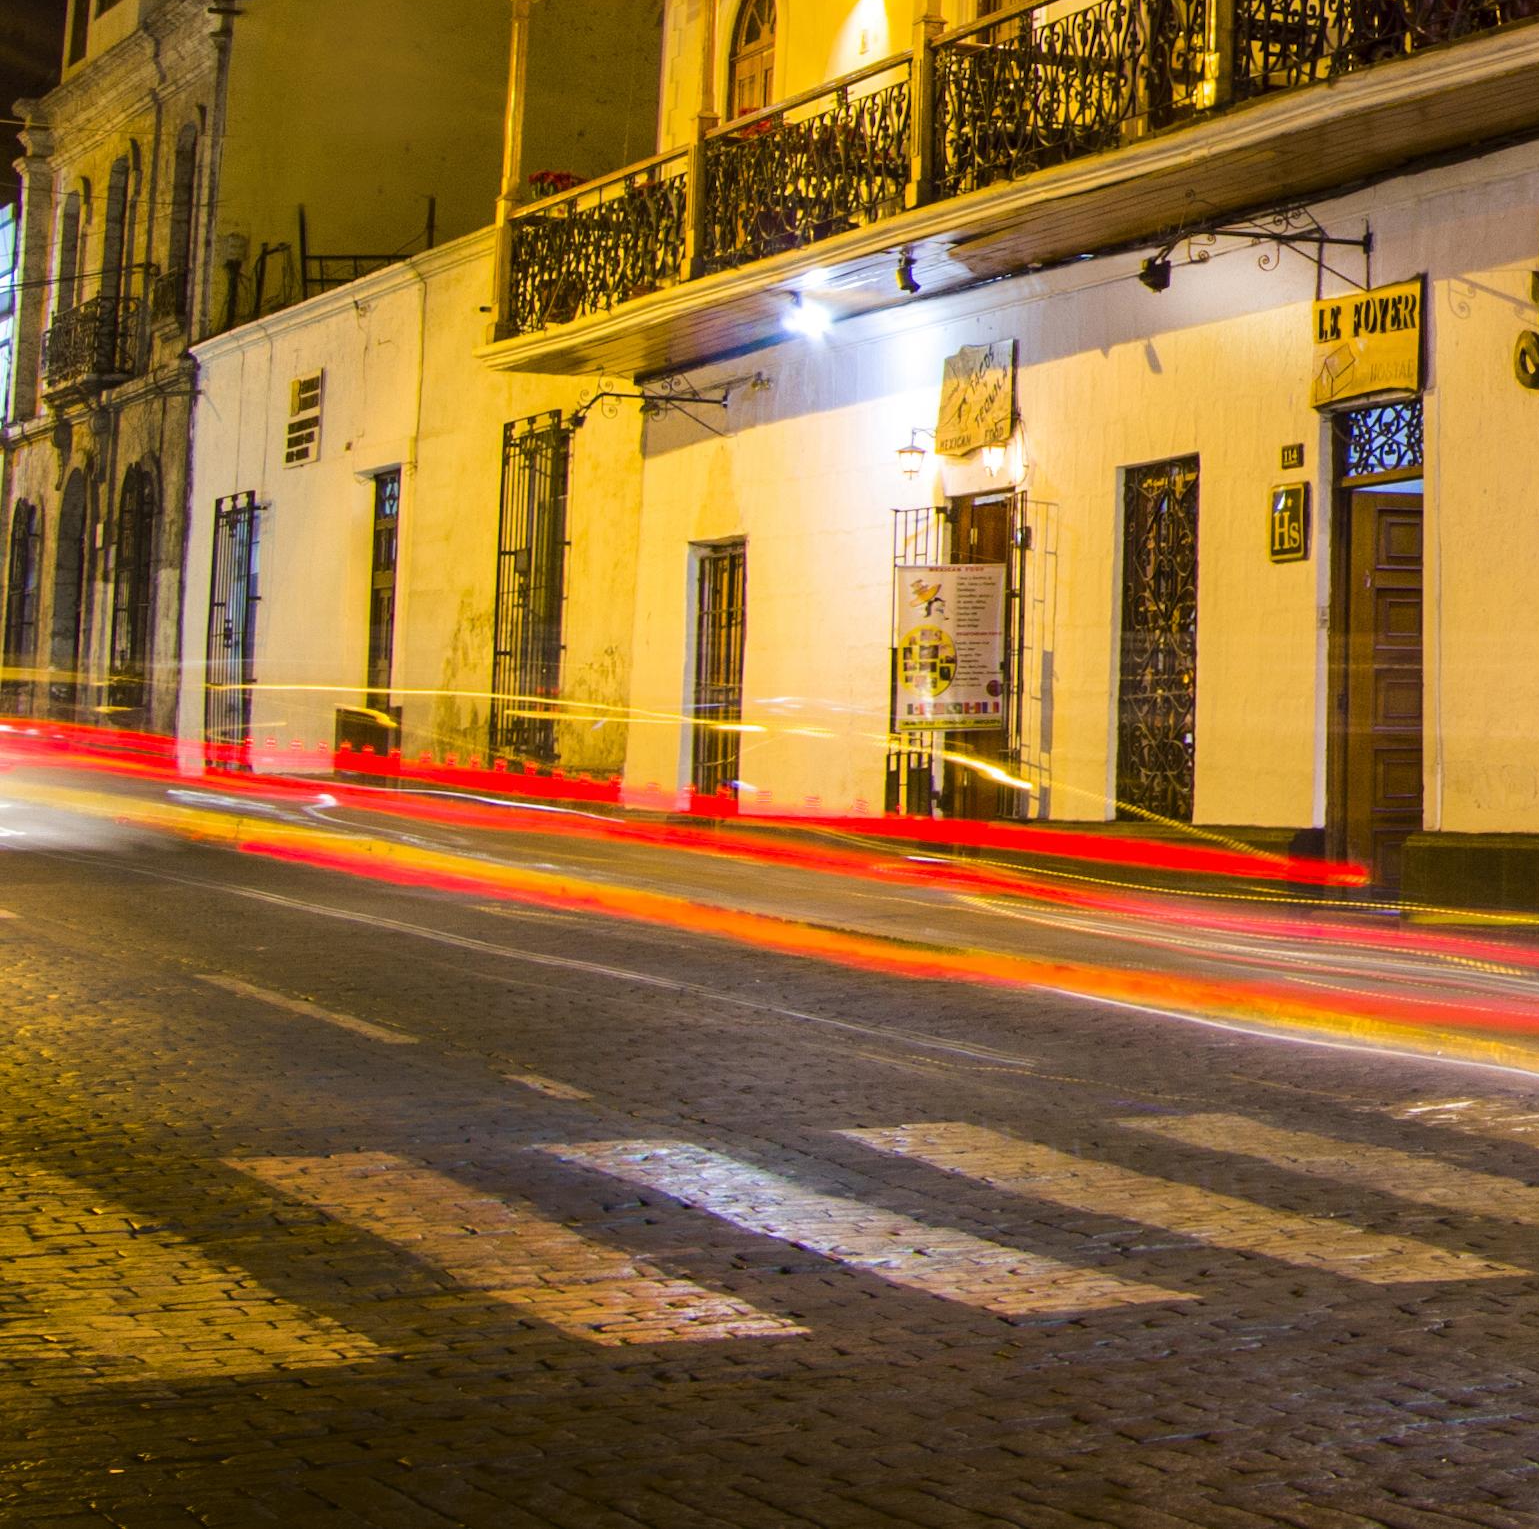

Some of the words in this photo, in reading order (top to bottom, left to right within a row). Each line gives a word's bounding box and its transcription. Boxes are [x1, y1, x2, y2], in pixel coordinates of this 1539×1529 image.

[1319, 306, 1341, 343] LE
[1353, 294, 1416, 337] FOYER
[971, 343, 994, 393] TACOS
[1370, 359, 1412, 383] HOSTAL
[975, 365, 1007, 428] TEQUILA
[940, 433, 971, 451] MEXICAN
[1284, 449, 1298, 462] 114
[1273, 511, 1299, 550] Hs
